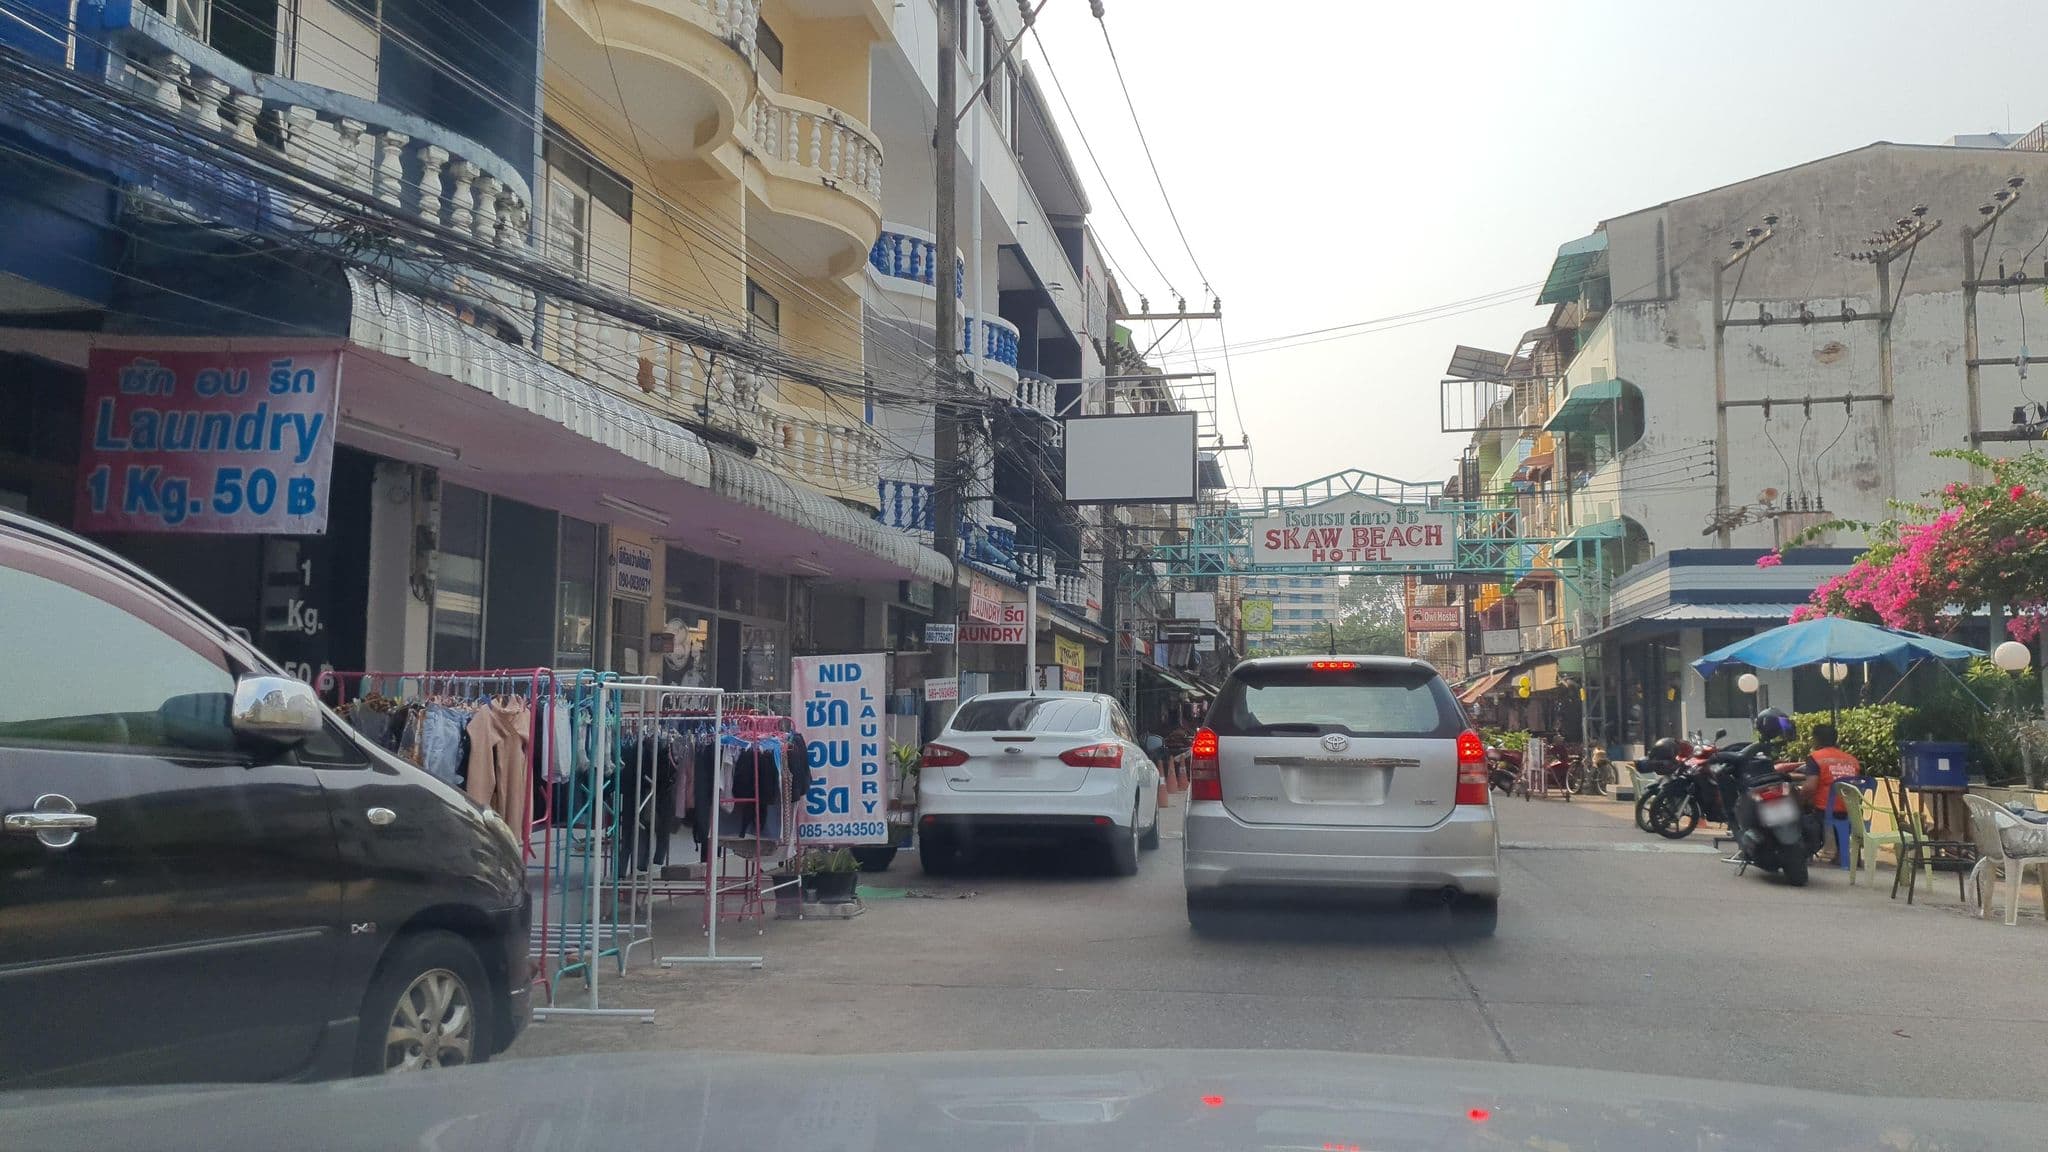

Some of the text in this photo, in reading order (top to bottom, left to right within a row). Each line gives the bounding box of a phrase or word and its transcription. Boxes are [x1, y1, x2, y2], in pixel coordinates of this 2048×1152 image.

[194, 368, 248, 396] อบ
[94, 397, 325, 464] Laundry
[88, 465, 111, 513] 1
[123, 465, 203, 526] Kg.
[212, 466, 278, 516] 50
[1285, 510, 1345, 528] โรงแรม
[1265, 525, 1443, 550] SKAW BEACH
[1312, 548, 1392, 562] HOTEL
[301, 560, 312, 586] 1
[287, 599, 324, 636] Kg.
[972, 597, 1000, 623] LAUNDRY
[1004, 605, 1024, 622] รีด
[1437, 611, 1458, 622] Hostel
[958, 627, 1023, 642] AUNDRY
[819, 663, 862, 682] NID
[805, 690, 849, 727] ซัก
[807, 740, 849, 768] อบ
[860, 687, 878, 814] LAUNDRY
[805, 777, 849, 815] รีด
[799, 822, 885, 838] 085-3343503
